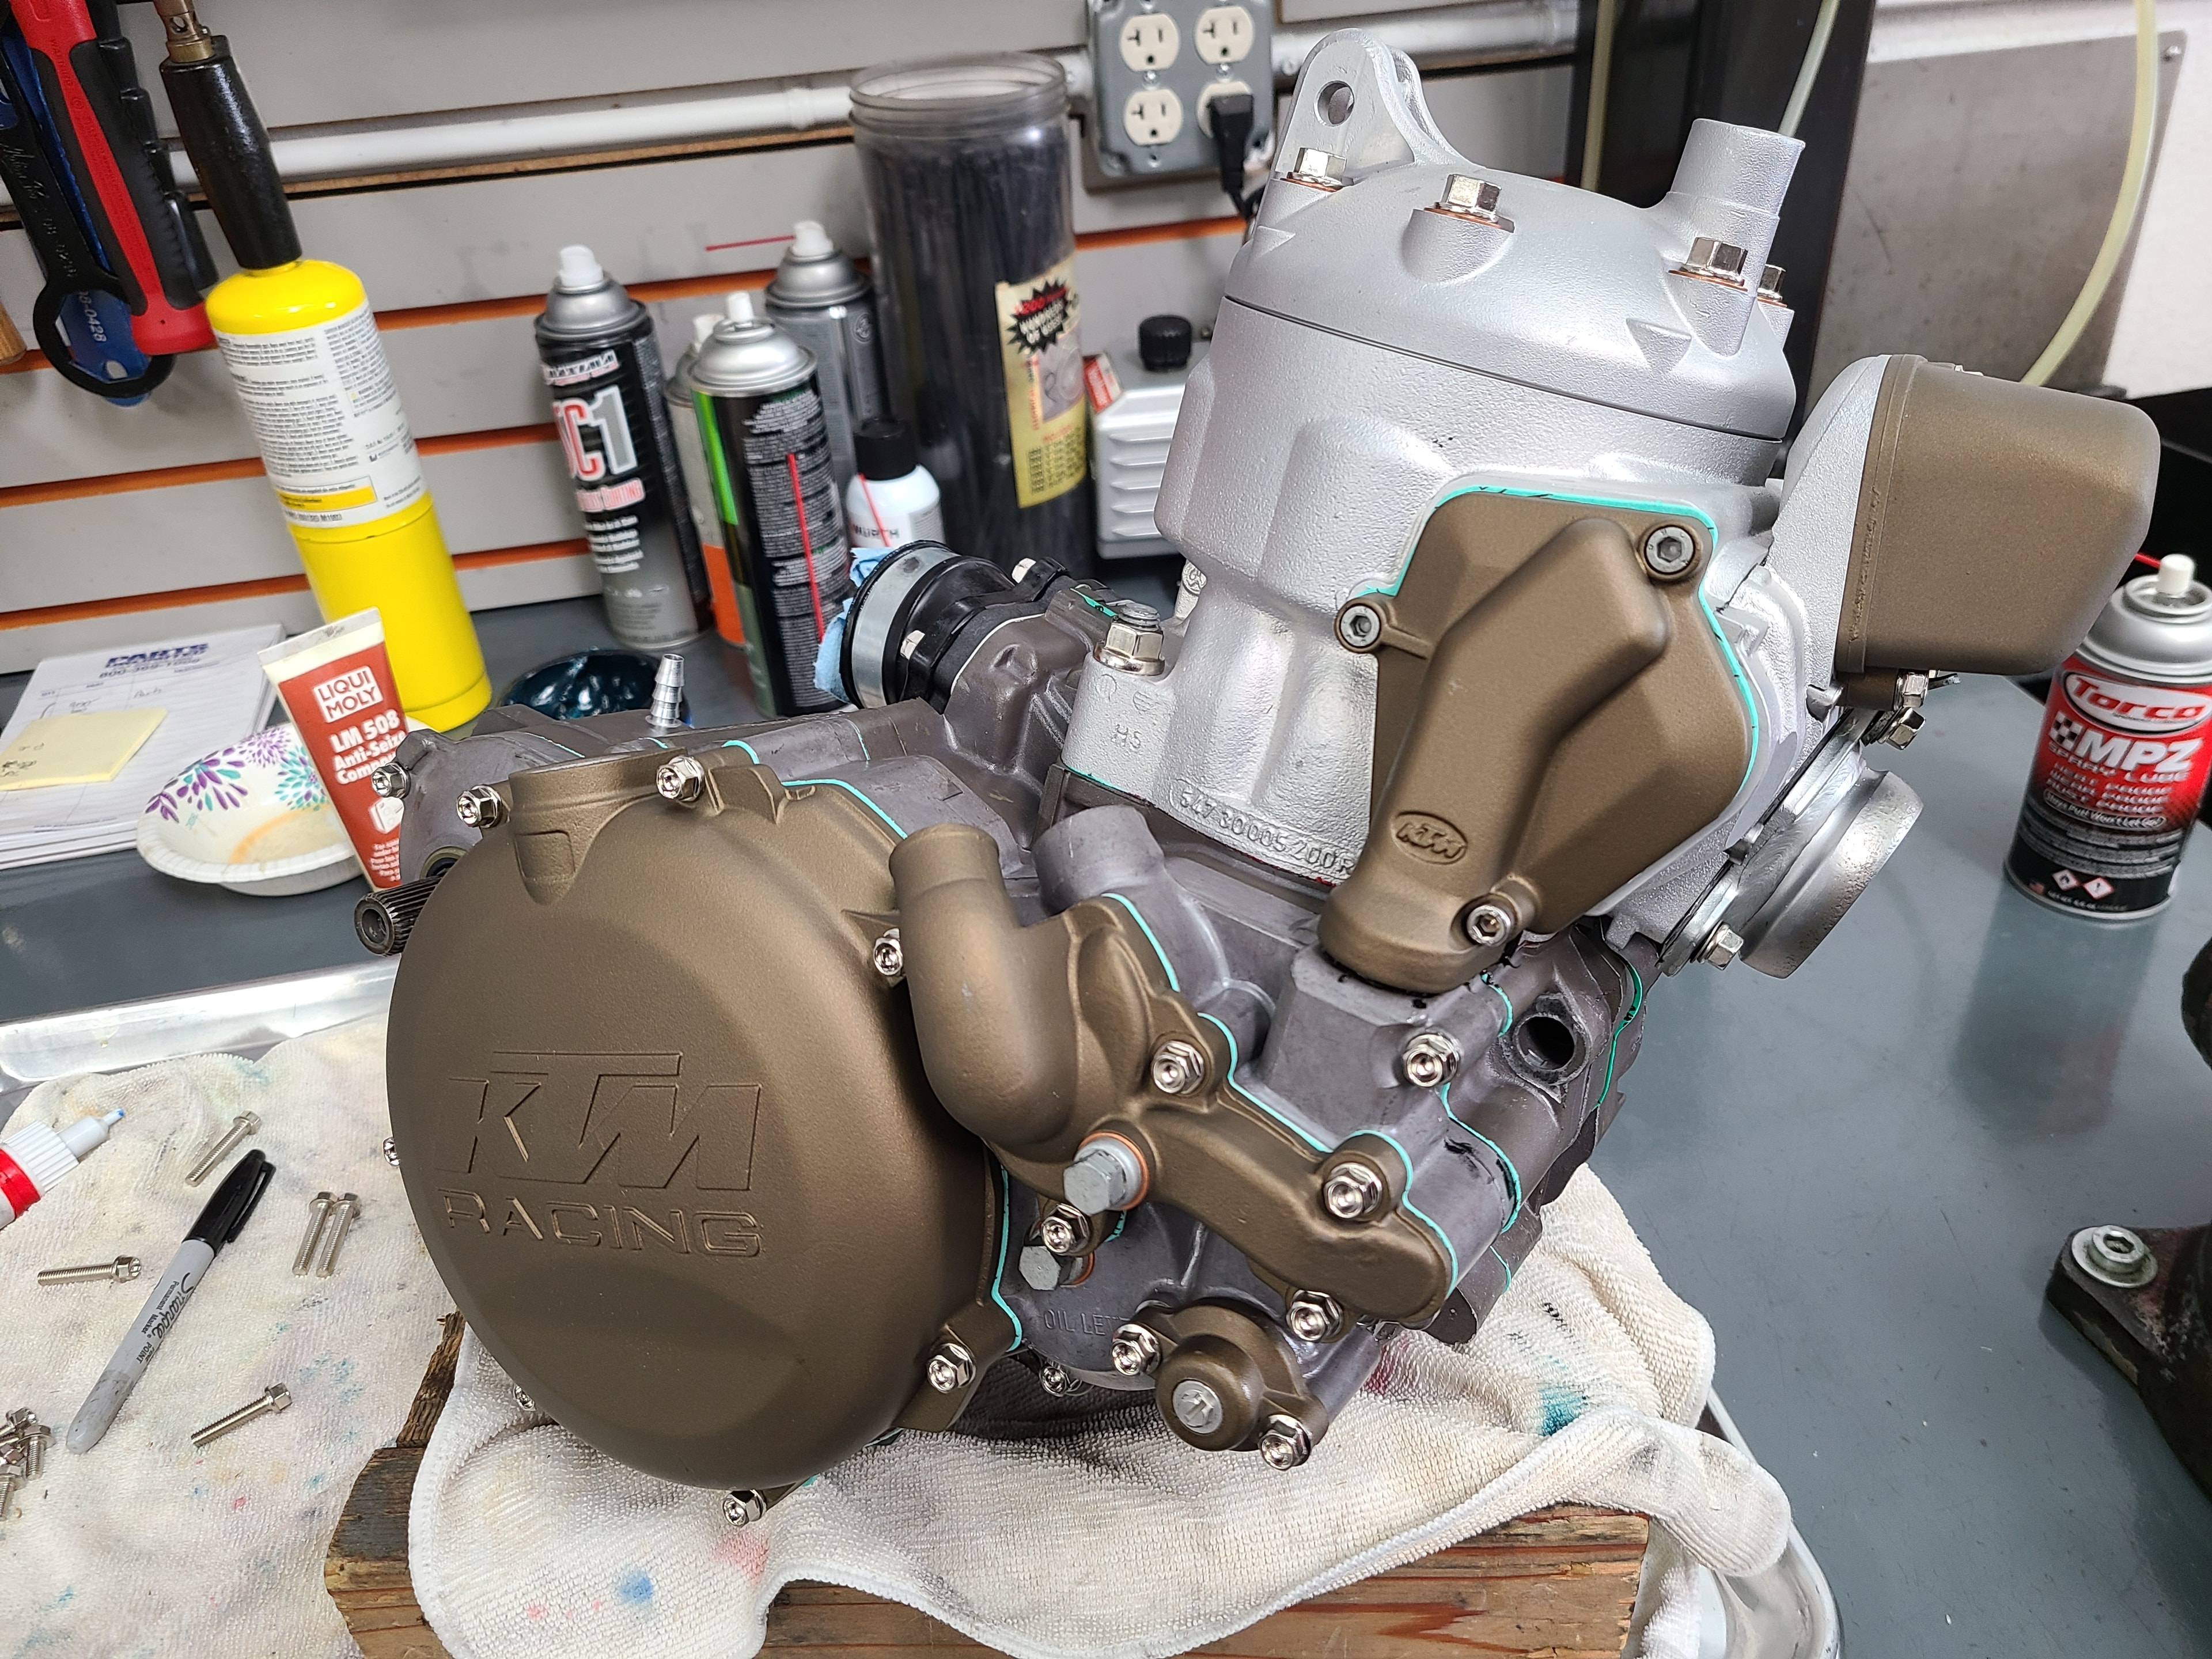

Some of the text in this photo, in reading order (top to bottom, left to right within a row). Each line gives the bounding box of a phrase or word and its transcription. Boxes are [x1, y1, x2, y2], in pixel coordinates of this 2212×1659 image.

[105, 643, 209, 668] PARTS
[318, 670, 372, 702] LIQUI
[325, 685, 376, 719] MOLY
[2074, 677, 2206, 719] Torco
[329, 709, 401, 753] LM 508
[2075, 728, 2205, 773] MPZ
[1395, 823, 1467, 859] KTM
[435, 1050, 762, 1191] KTM
[437, 1188, 762, 1257] RACING
[141, 1281, 180, 1334] Permanent Marker
[1044, 1309, 1075, 1333] OIL
[136, 1342, 153, 1364] POINT
